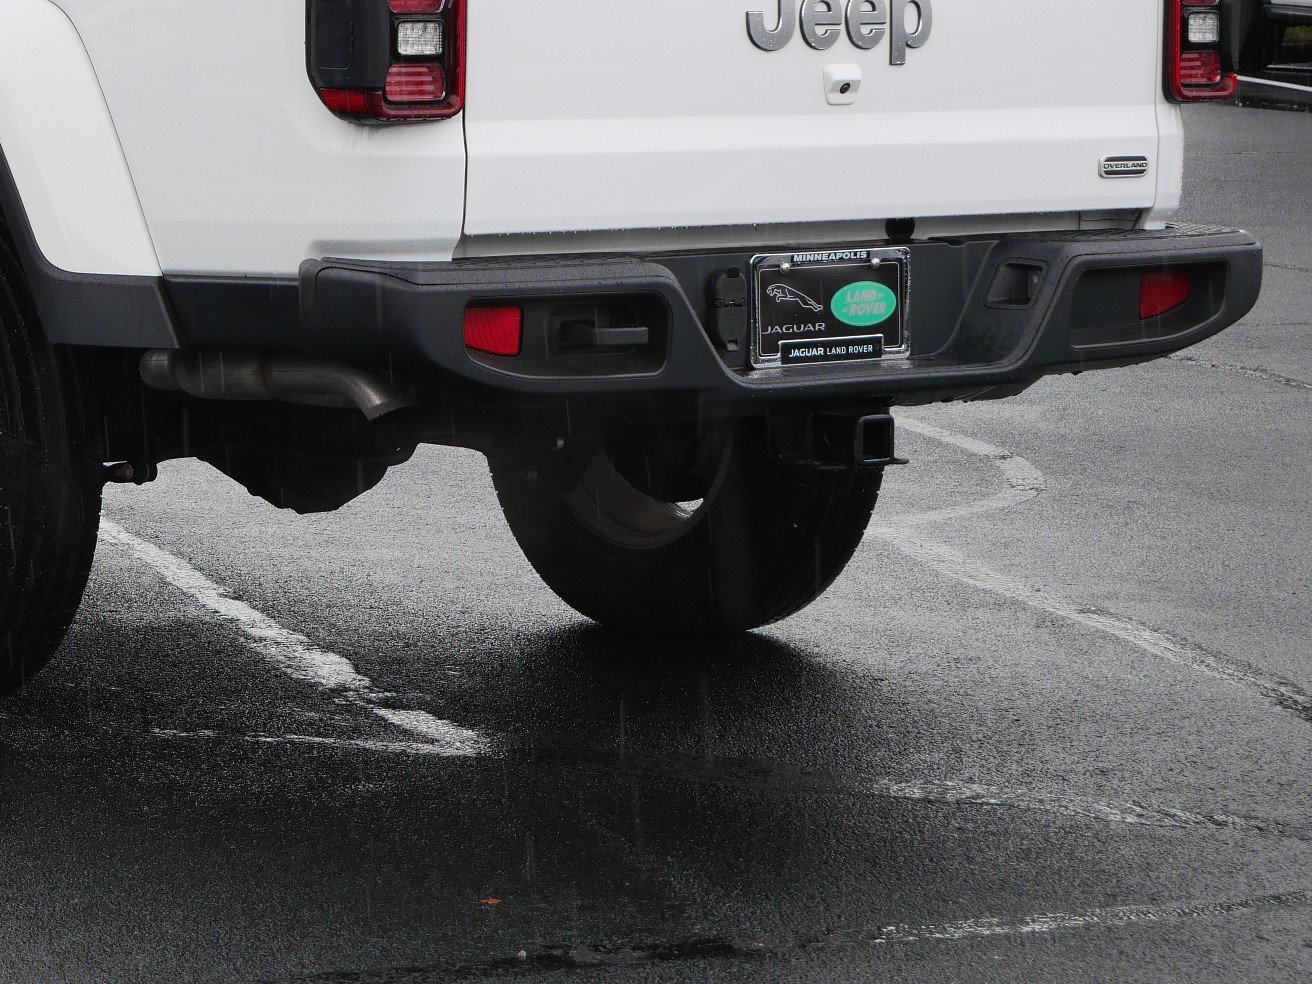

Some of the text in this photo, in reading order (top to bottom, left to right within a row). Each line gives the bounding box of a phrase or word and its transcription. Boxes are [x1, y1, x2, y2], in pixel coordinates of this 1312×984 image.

[1103, 161, 1148, 170] OVERLAND
[793, 251, 867, 263] MINNEAPOLIS
[845, 290, 877, 303] LAND
[848, 301, 886, 316] ROVER
[762, 322, 826, 335] JAGUAR
[789, 344, 873, 358] JAGUAR LAND ROVER
